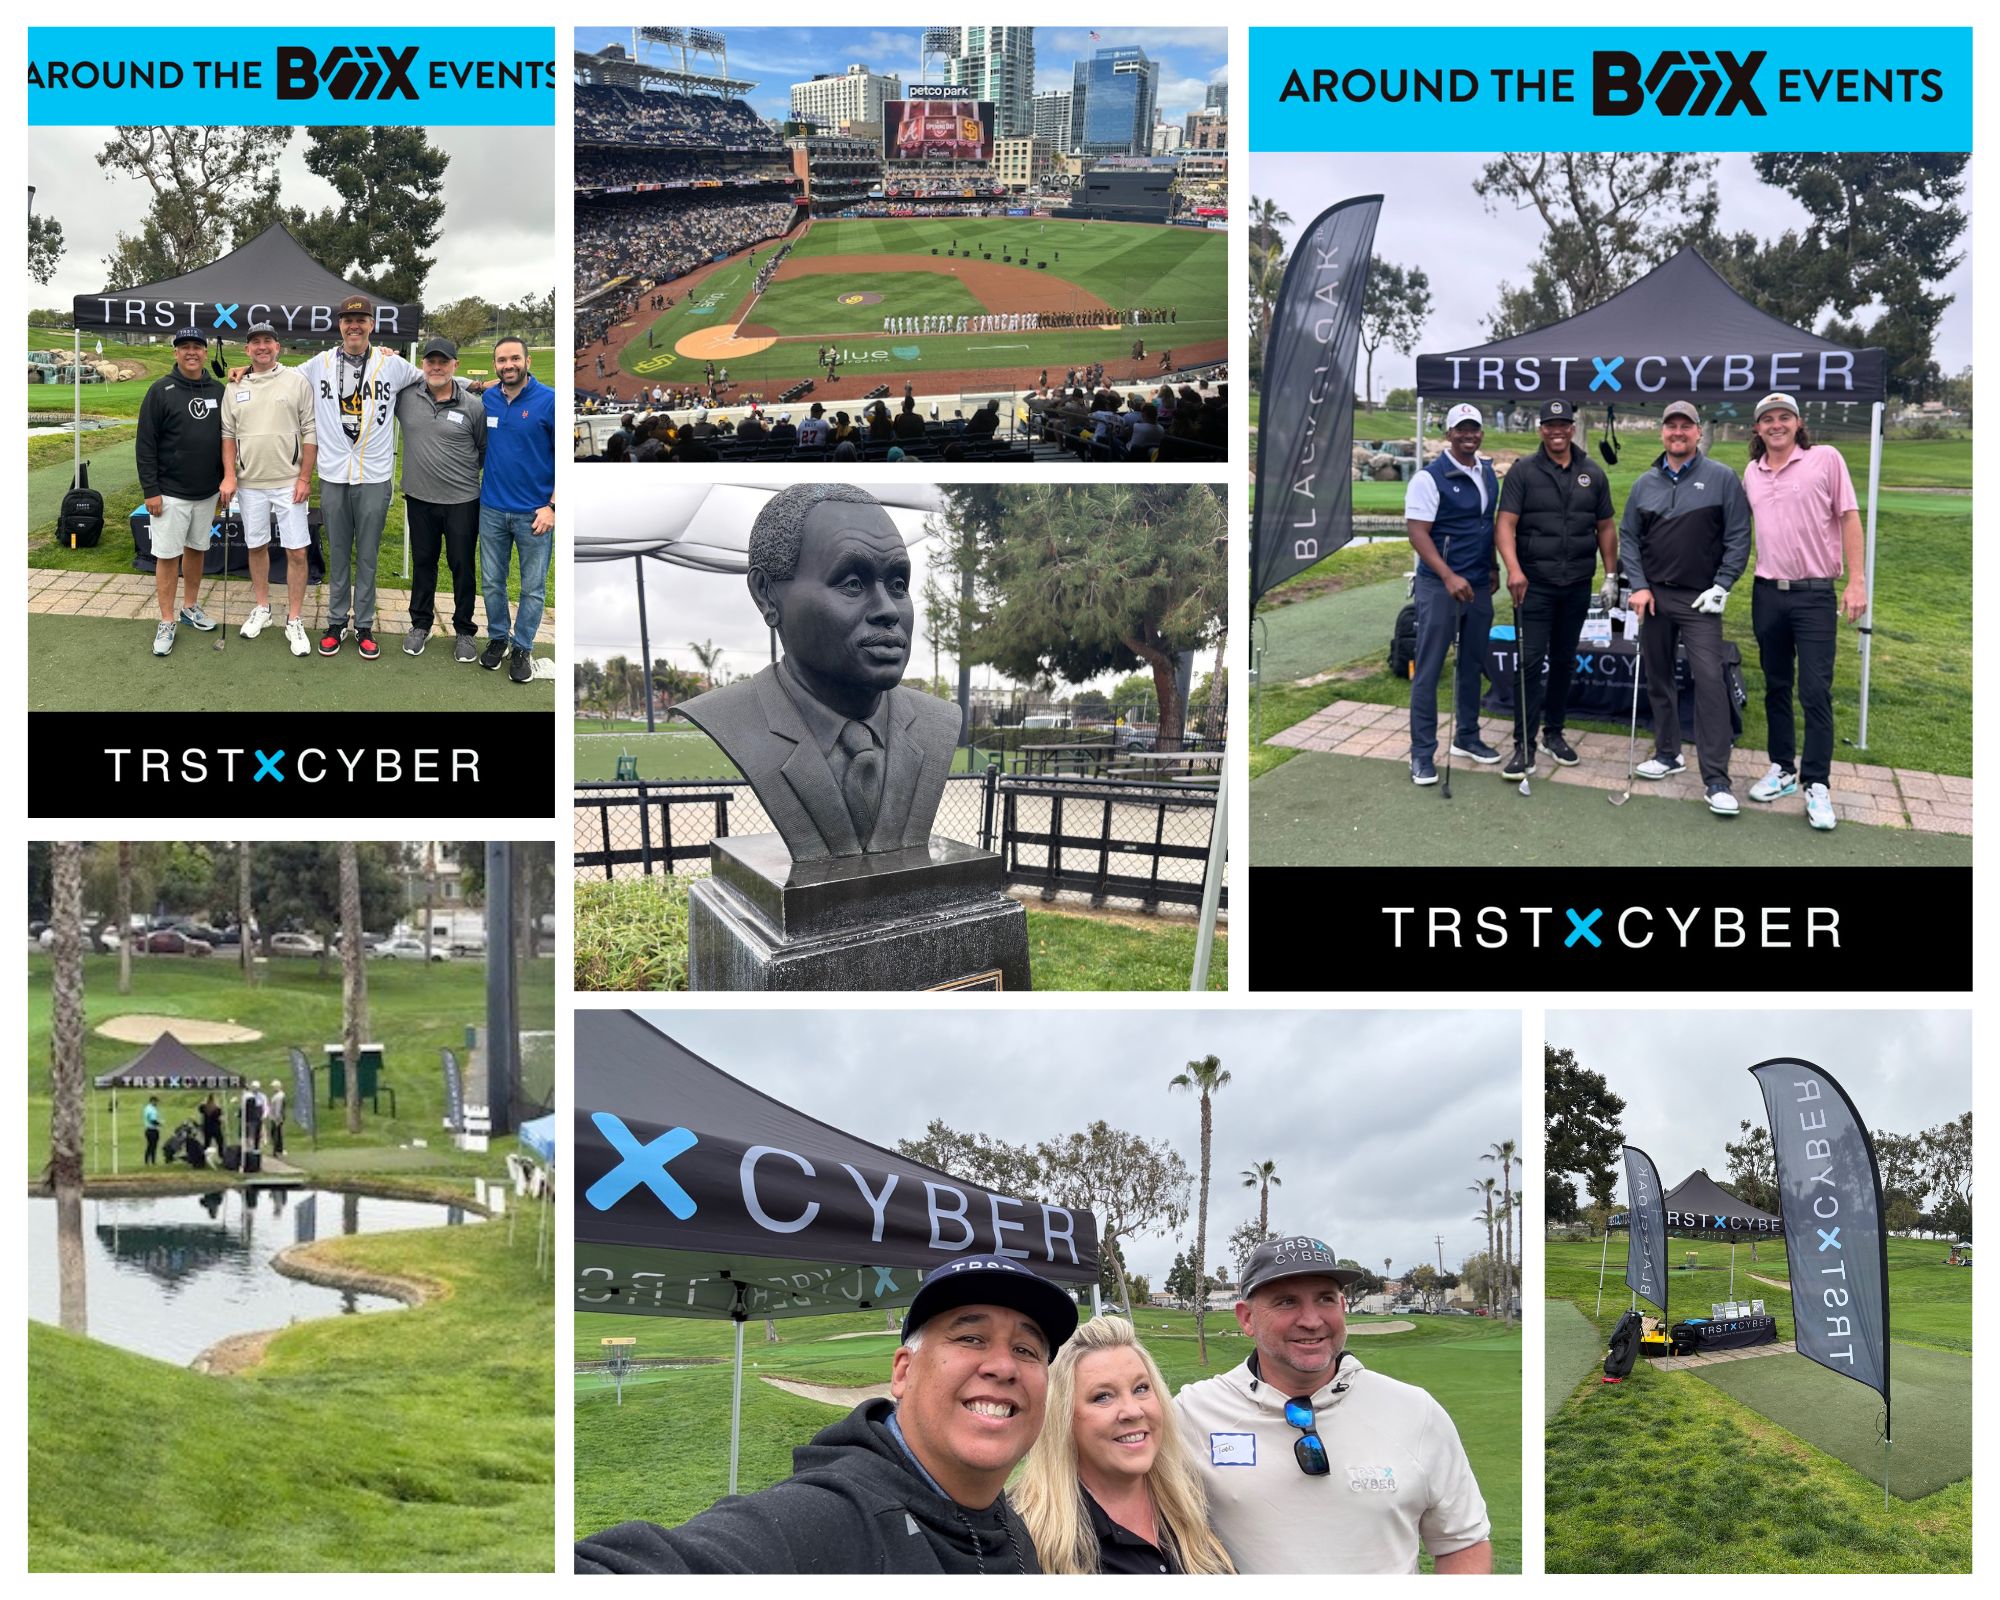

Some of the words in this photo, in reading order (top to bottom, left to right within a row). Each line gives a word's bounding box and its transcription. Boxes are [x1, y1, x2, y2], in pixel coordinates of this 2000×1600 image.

[909, 86, 942, 98] petco
[944, 86, 969, 98] park
[98, 297, 399, 334] TRSTXCYBR
[1445, 351, 1855, 393] TRSTXCYBER
[376, 404, 387, 426] 3
[801, 430, 818, 444] 27
[1275, 1250, 1334, 1265] CYBER
